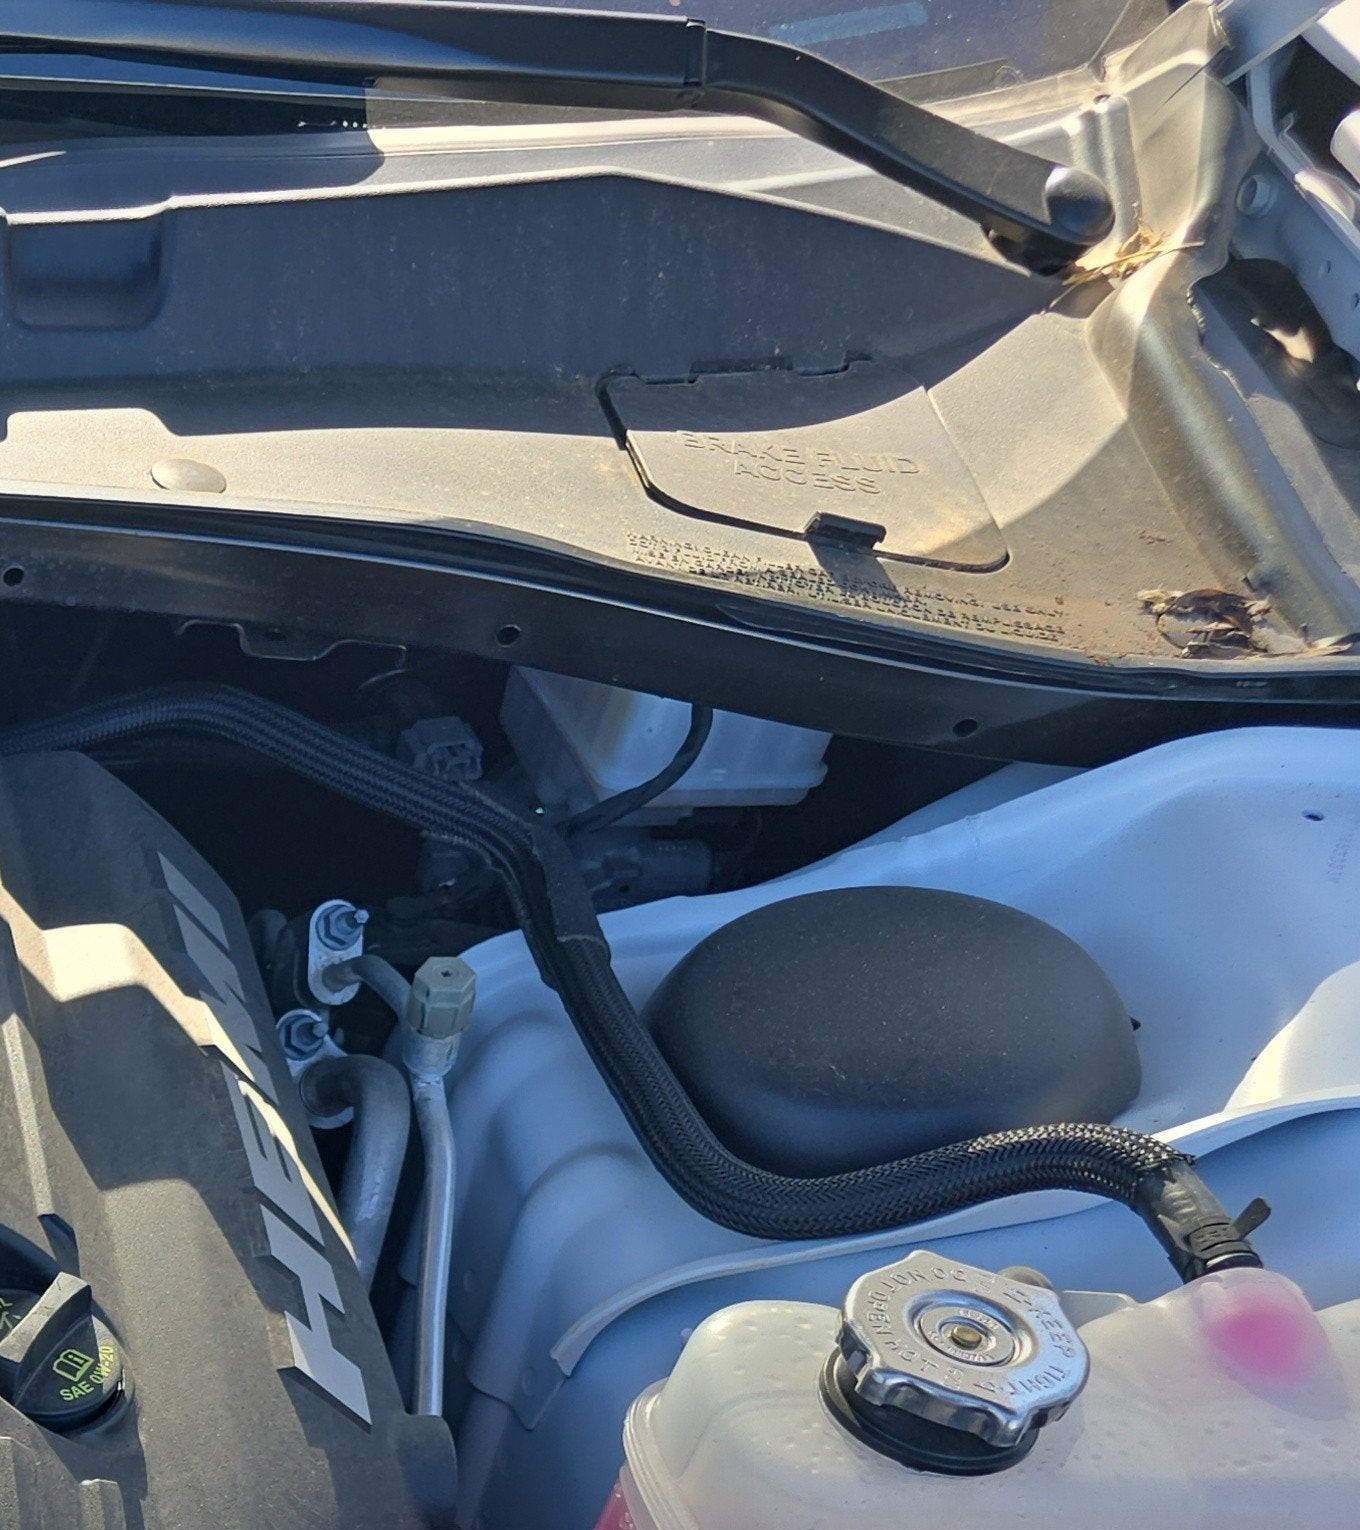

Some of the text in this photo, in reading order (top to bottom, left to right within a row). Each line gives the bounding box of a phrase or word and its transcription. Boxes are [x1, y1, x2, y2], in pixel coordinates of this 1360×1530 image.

[679, 432, 922, 475] BRAKE FLUID
[733, 459, 881, 494] ACCESS
[157, 852, 371, 1425] HEMI
[59, 1345, 114, 1401] SAE 0W-20
